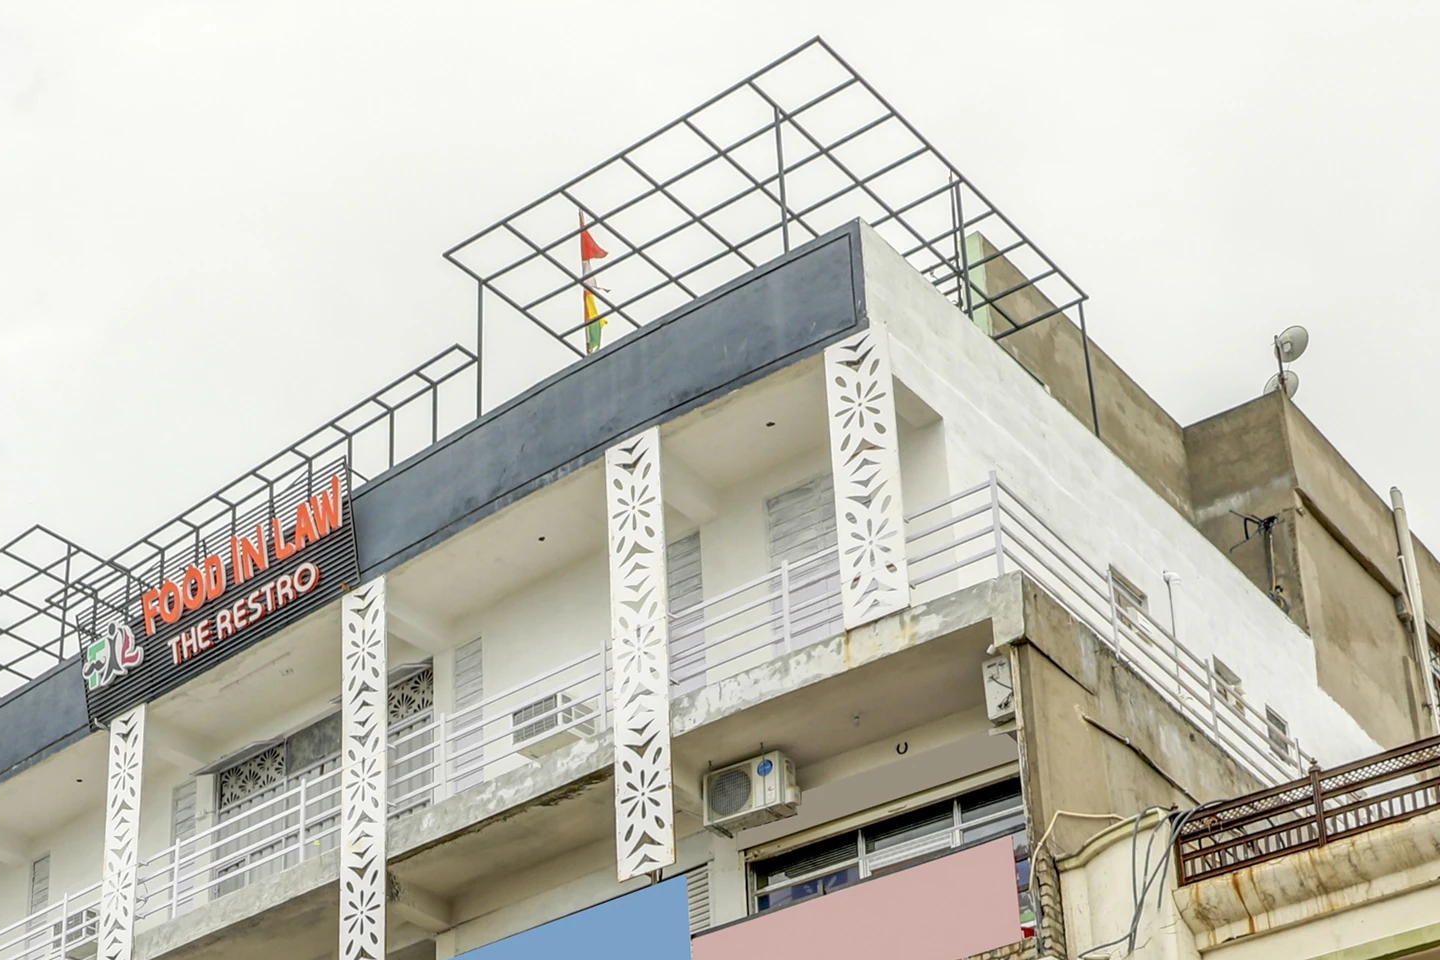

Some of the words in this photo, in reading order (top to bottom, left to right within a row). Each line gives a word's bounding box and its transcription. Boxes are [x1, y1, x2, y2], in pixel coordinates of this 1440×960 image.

[141, 555, 227, 636] FOOD
[231, 524, 269, 585] IN
[272, 474, 344, 560] LAW
[167, 620, 214, 665] THE
[216, 562, 320, 640] RESTRO
